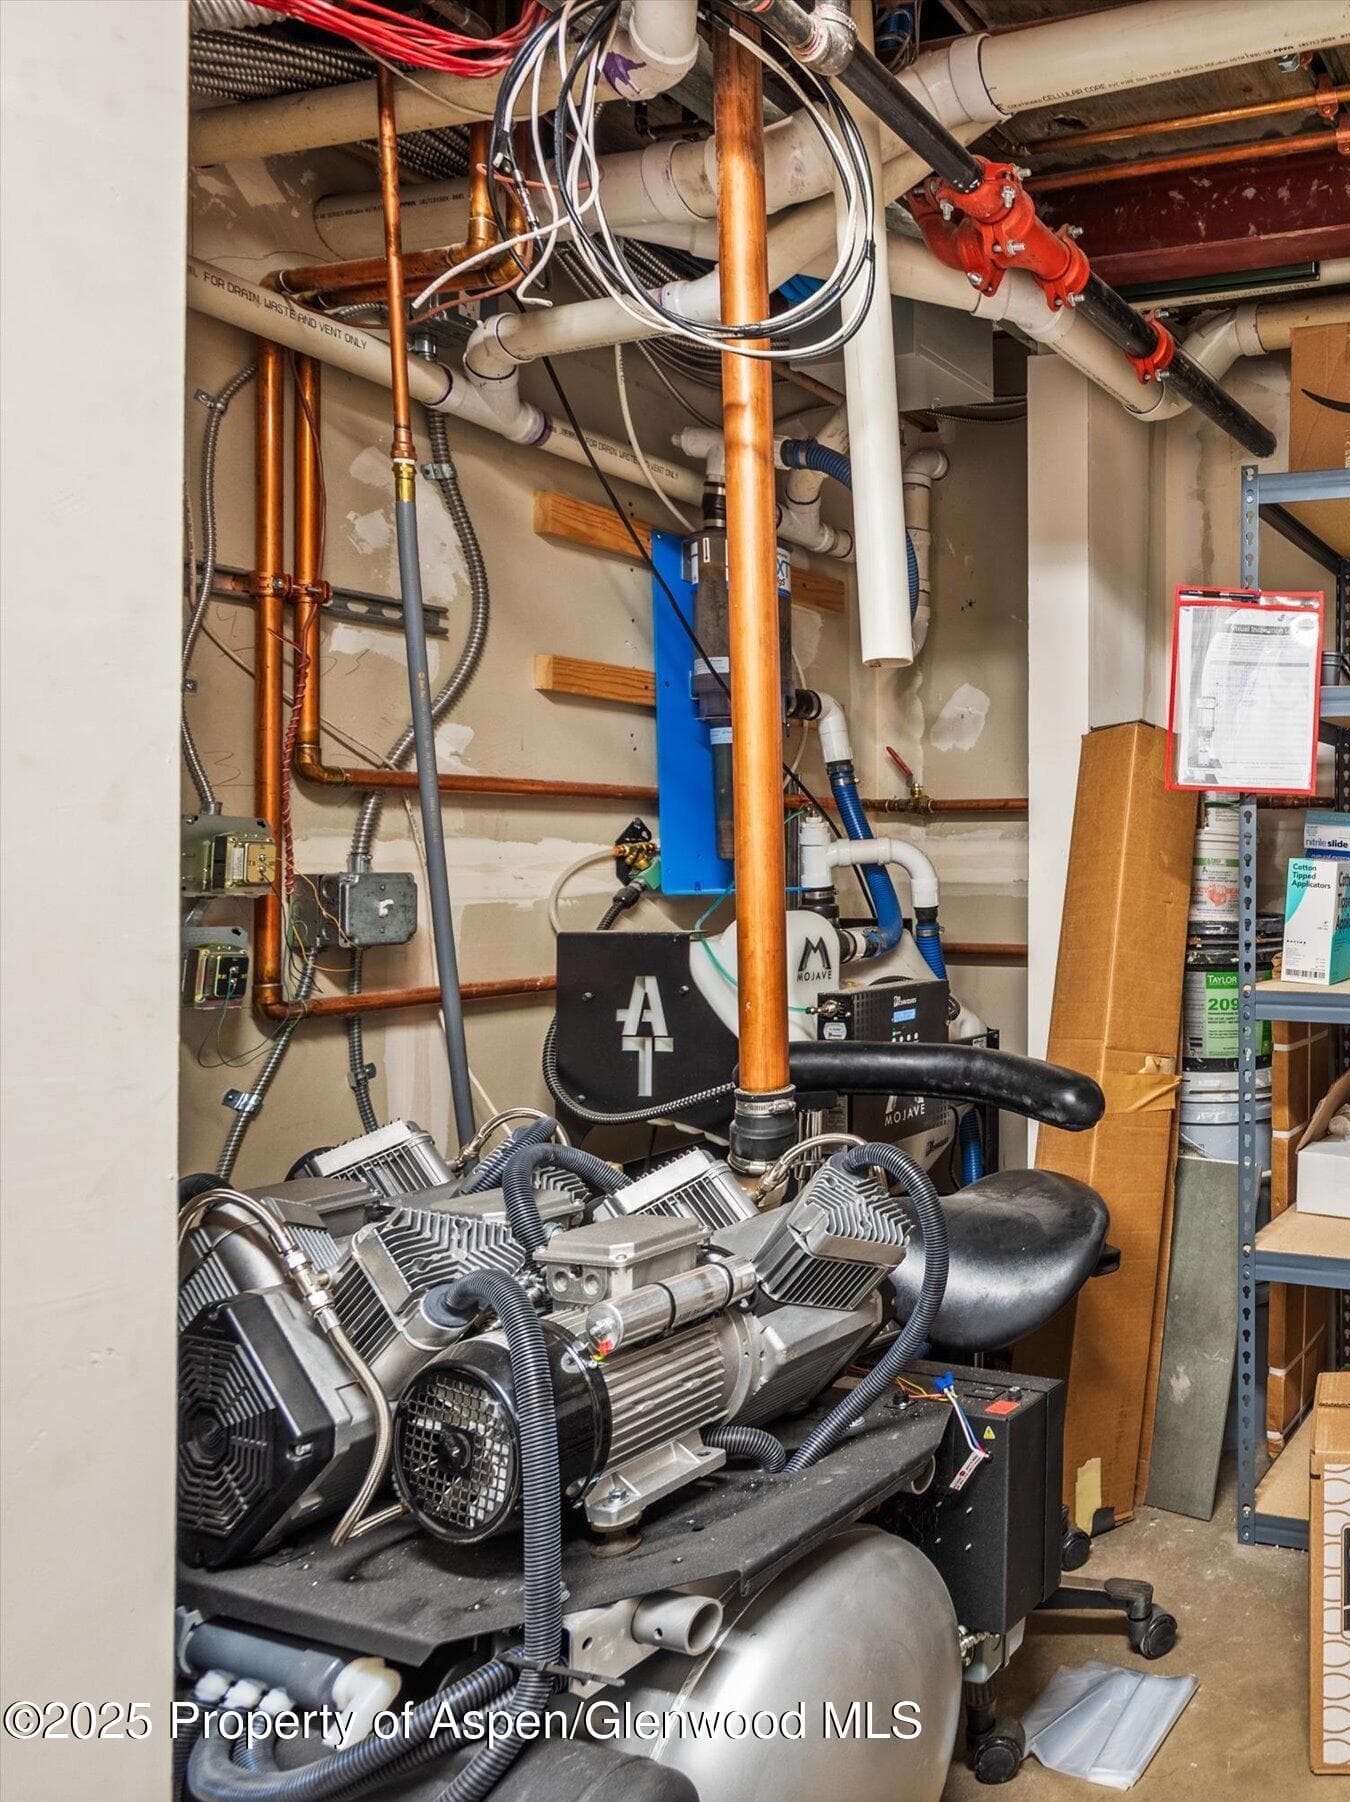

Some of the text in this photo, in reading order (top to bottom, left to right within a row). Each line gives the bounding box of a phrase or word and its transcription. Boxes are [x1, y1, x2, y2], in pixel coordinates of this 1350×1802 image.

[203, 271, 225, 290] FOR
[264, 298, 296, 320] WASTE
[297, 313, 317, 330] AND
[319, 322, 342, 340] VENT
[343, 332, 367, 350] ONLY
[1327, 839, 1349, 849] slide
[1292, 863, 1317, 871] Cotton
[1292, 872, 1316, 881] Tipped
[1291, 880, 1331, 889] Applicators
[797, 970, 832, 982] MOJAVE
[1208, 974, 1237, 984] TAYLOR
[884, 1103, 926, 1127] MOJAVE
